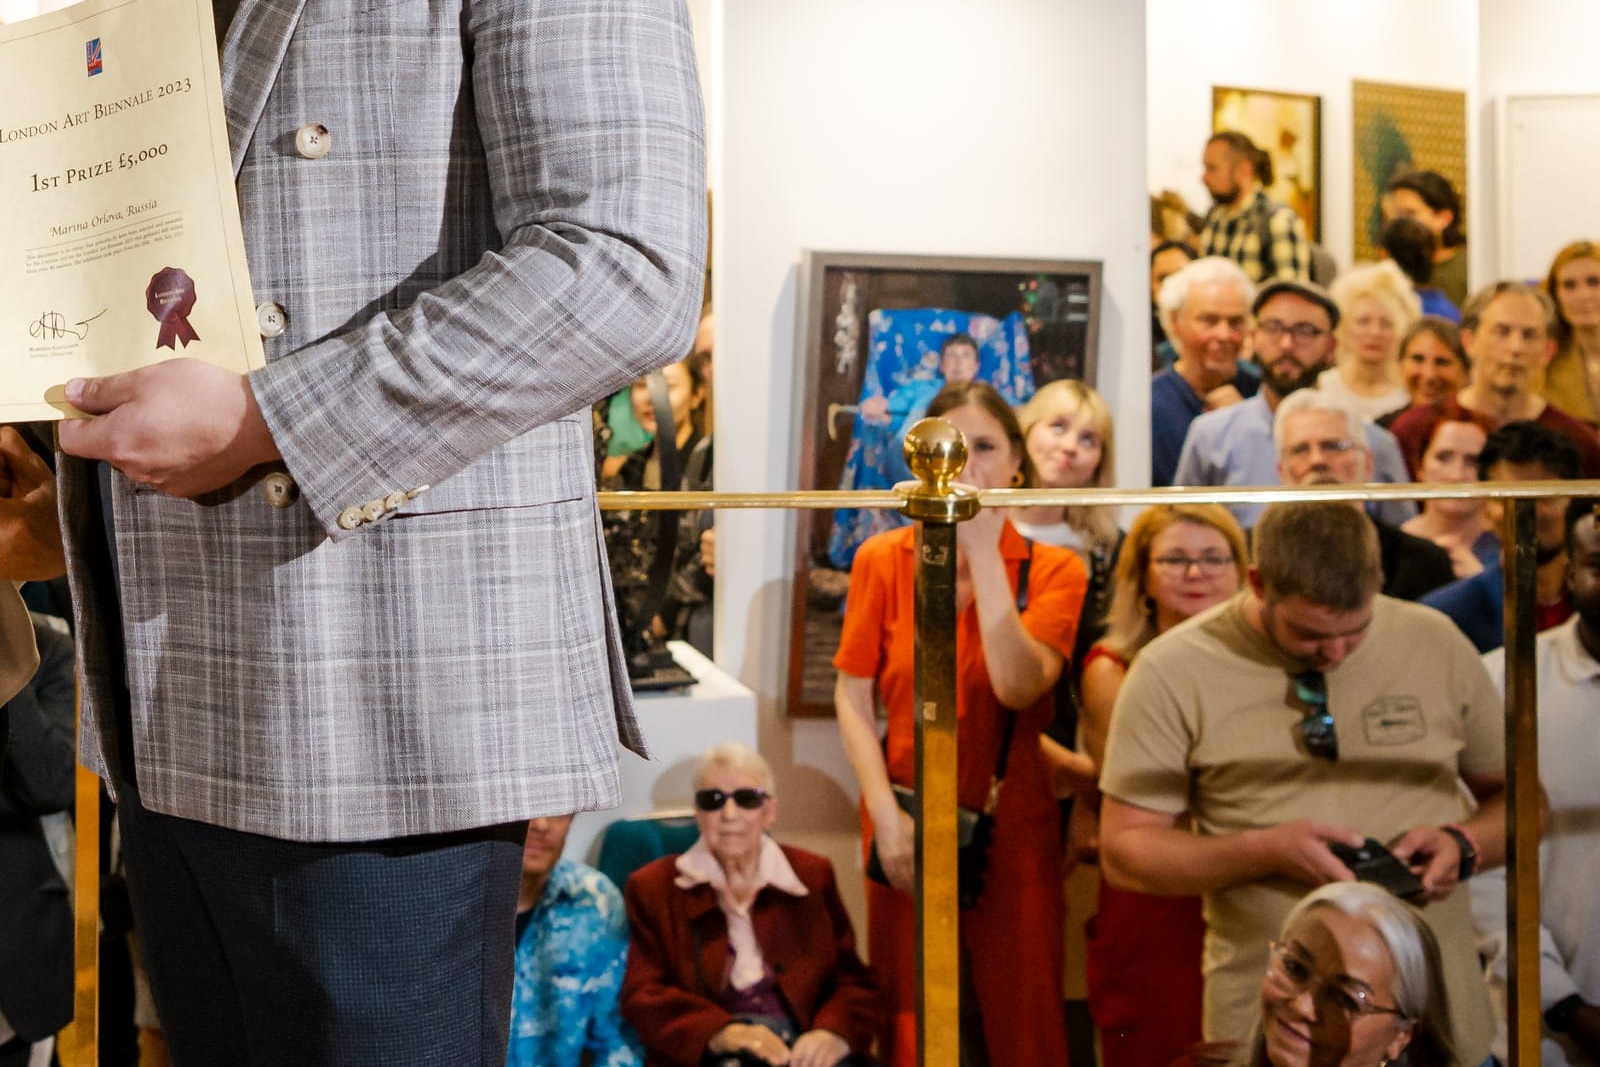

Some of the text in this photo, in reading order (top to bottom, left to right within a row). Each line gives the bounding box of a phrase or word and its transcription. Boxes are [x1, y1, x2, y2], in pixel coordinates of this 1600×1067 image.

[158, 78, 192, 98] 2023
[66, 160, 113, 184] PRIZE
[118, 143, 168, 170] £5,000
[50, 199, 158, 237] Marina Orlova, Russia
